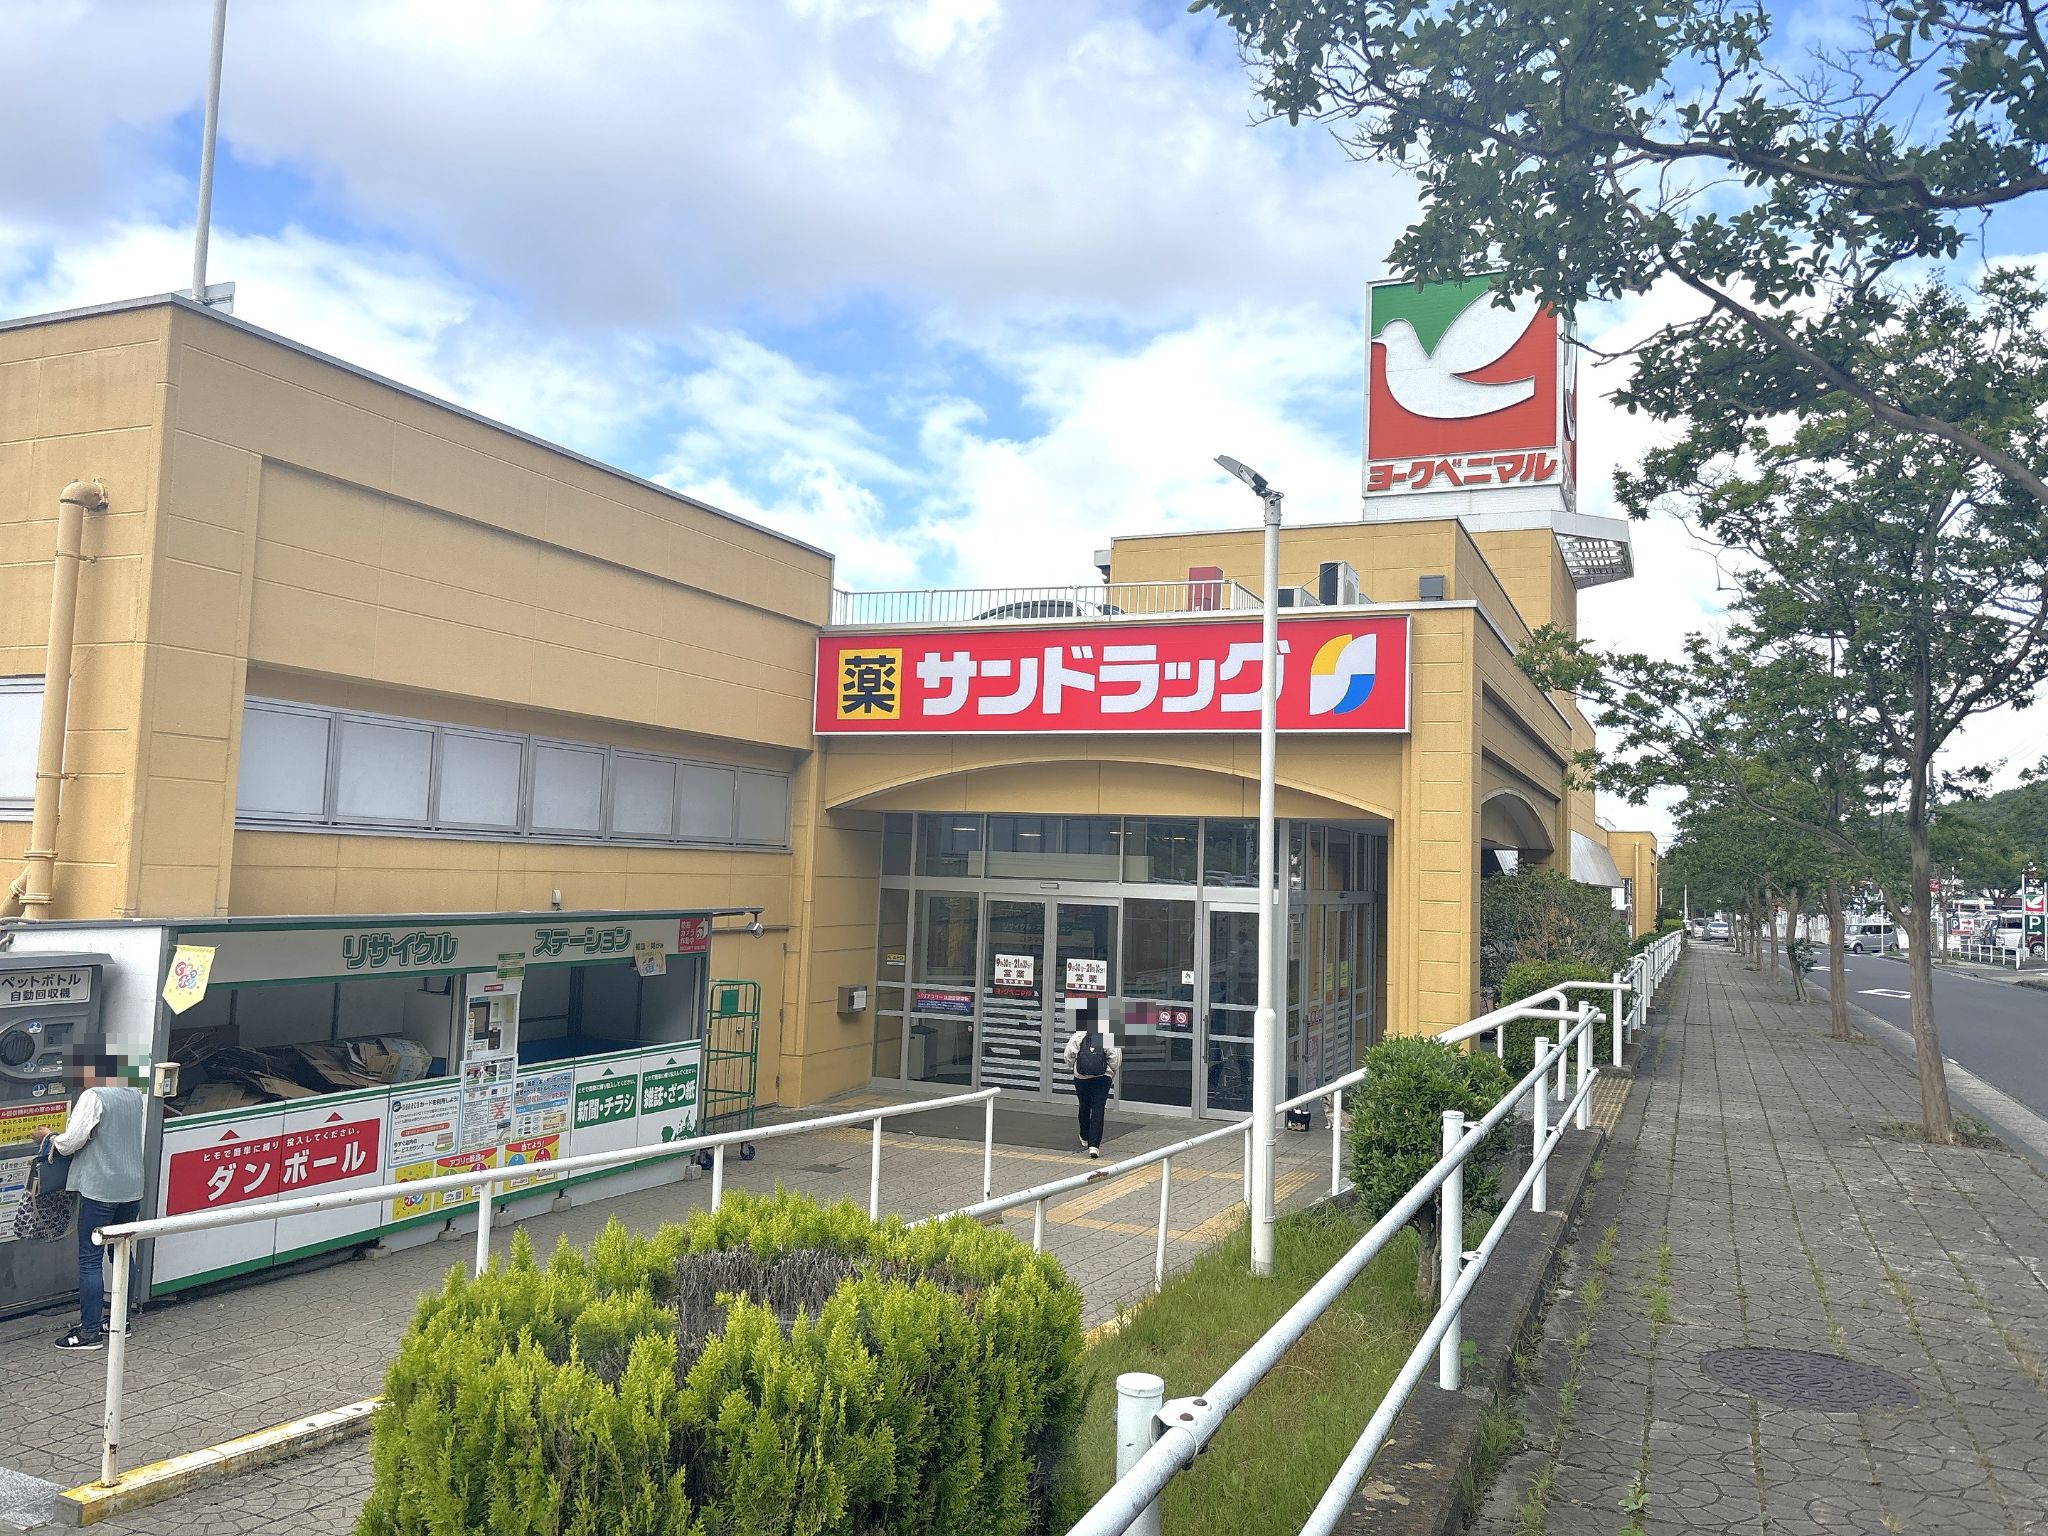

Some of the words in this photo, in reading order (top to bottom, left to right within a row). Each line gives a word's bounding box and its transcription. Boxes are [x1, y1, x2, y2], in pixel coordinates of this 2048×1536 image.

[1367, 453, 1558, 491] ヨークベニマル
[842, 655, 896, 714] 薬
[916, 639, 1289, 716] サンドラッグ
[2029, 916, 2042, 930] P
[342, 931, 459, 970] リサイクル
[533, 926, 633, 957] ステーション
[1, 973, 81, 989] ペットボトル
[10, 988, 71, 1002] 自動回収機
[577, 1093, 635, 1122] 新聞・チラシ
[643, 1080, 696, 1109] 雑誌・ざつ紙
